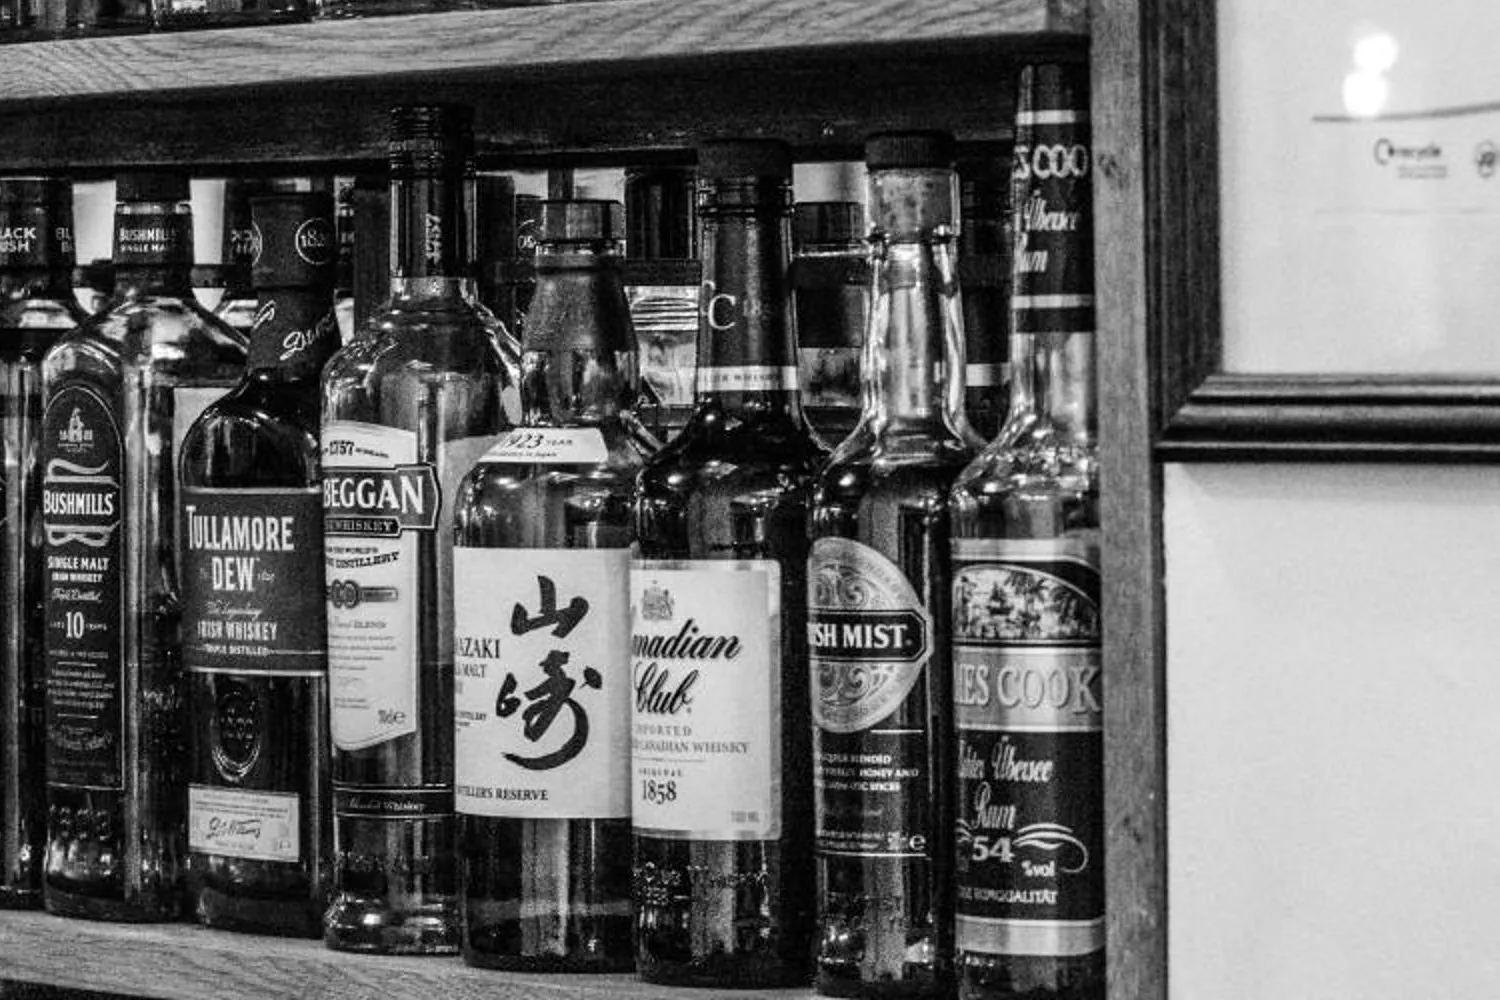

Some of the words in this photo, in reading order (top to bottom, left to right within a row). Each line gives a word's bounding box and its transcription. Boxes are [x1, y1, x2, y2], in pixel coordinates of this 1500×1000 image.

[43, 490, 113, 516] BUSHMILLS
[185, 504, 295, 551] TULLAMORE
[81, 557, 110, 571] MALT
[211, 557, 256, 592] DEW
[65, 611, 85, 639] 10
[225, 621, 278, 641] WHISKEY
[997, 665, 1102, 715] COOK
[692, 742, 750, 754] WHISKY
[495, 788, 549, 801] RESERVE
[642, 780, 677, 805] 1858
[971, 835, 1016, 863] 54
